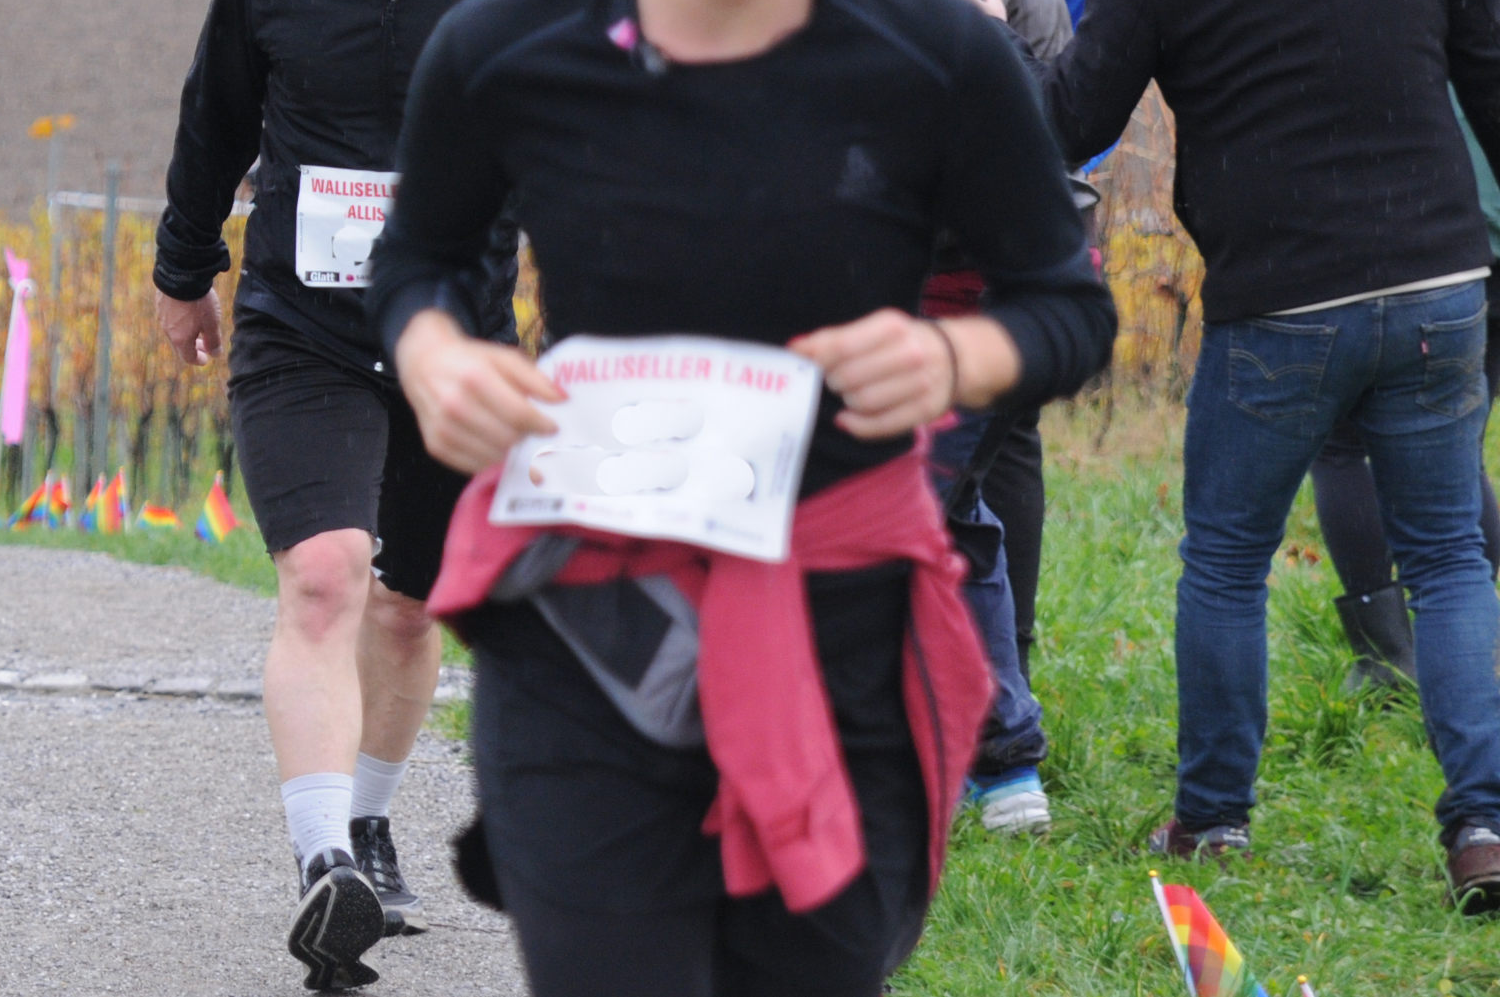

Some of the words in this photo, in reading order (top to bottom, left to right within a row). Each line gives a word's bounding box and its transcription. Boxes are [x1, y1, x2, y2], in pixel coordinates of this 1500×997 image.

[311, 178, 398, 198] WALLISELLE
[553, 354, 712, 387] WALLISELLER
[722, 362, 791, 394] LAUF
